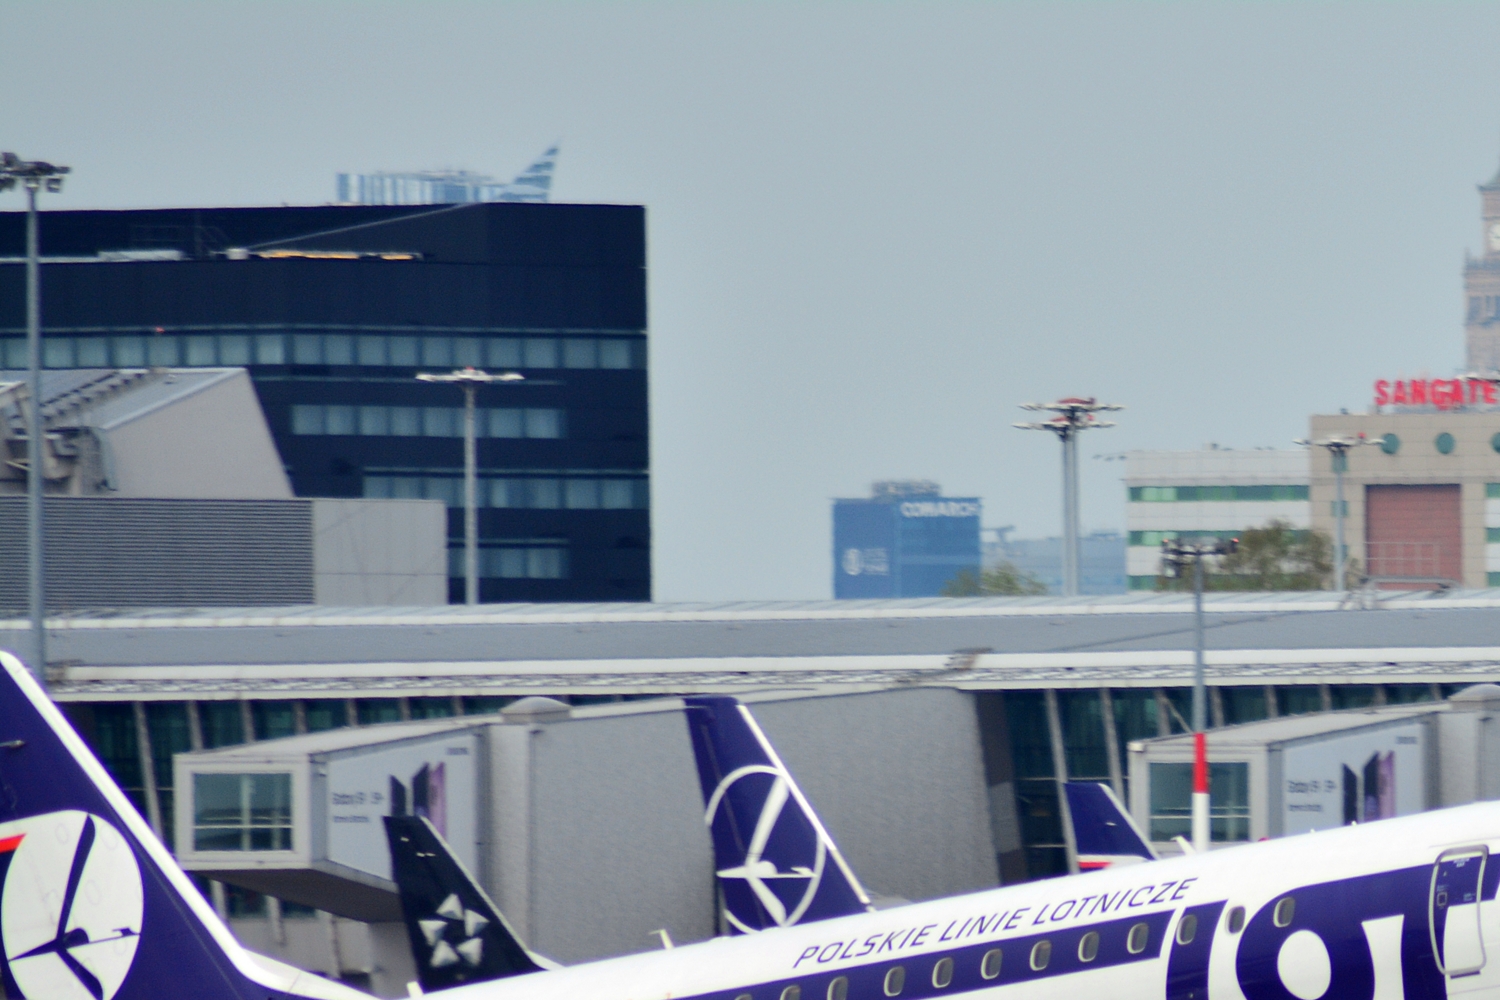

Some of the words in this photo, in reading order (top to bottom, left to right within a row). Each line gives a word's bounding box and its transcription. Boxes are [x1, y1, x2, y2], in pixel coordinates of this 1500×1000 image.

[1374, 379, 1497, 406] SANGATE
[793, 924, 938, 968] POLSKIE
[938, 907, 1032, 942] LINIE
[1032, 878, 1199, 926] LOTNICZE
